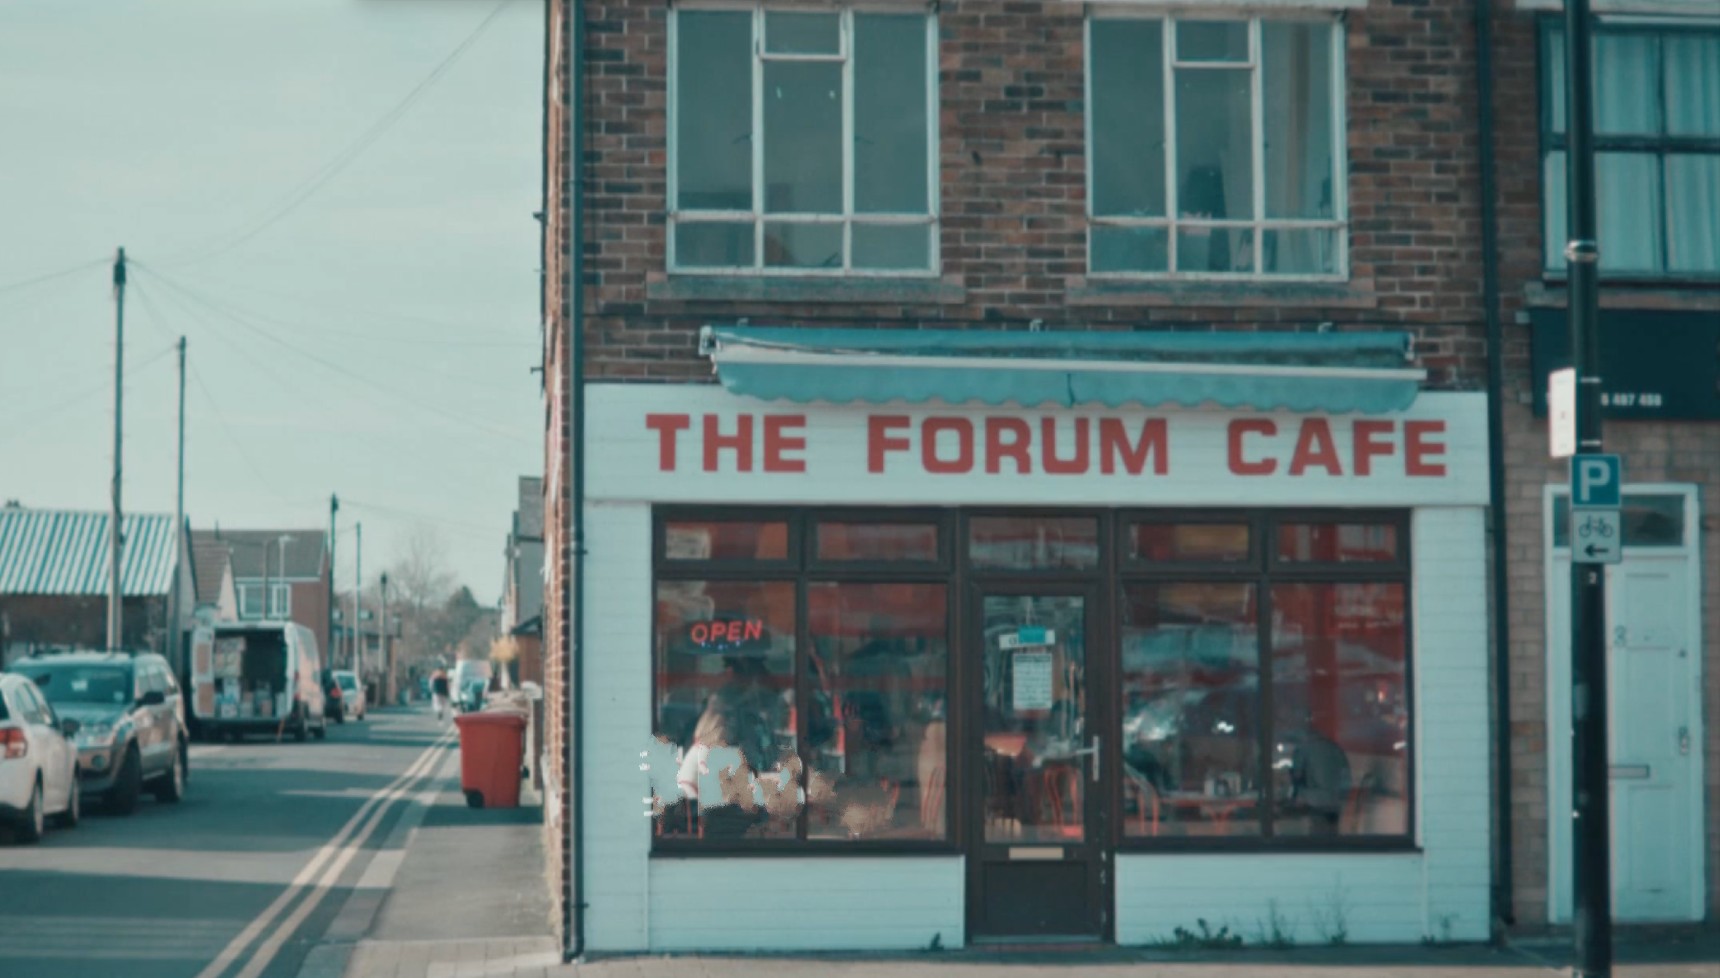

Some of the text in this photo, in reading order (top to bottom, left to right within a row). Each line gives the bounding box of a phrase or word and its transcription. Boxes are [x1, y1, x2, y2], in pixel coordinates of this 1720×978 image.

[647, 415, 1445, 475] THE FORUM CAFE
[1579, 460, 1610, 502] P
[690, 618, 763, 644] OPEN
